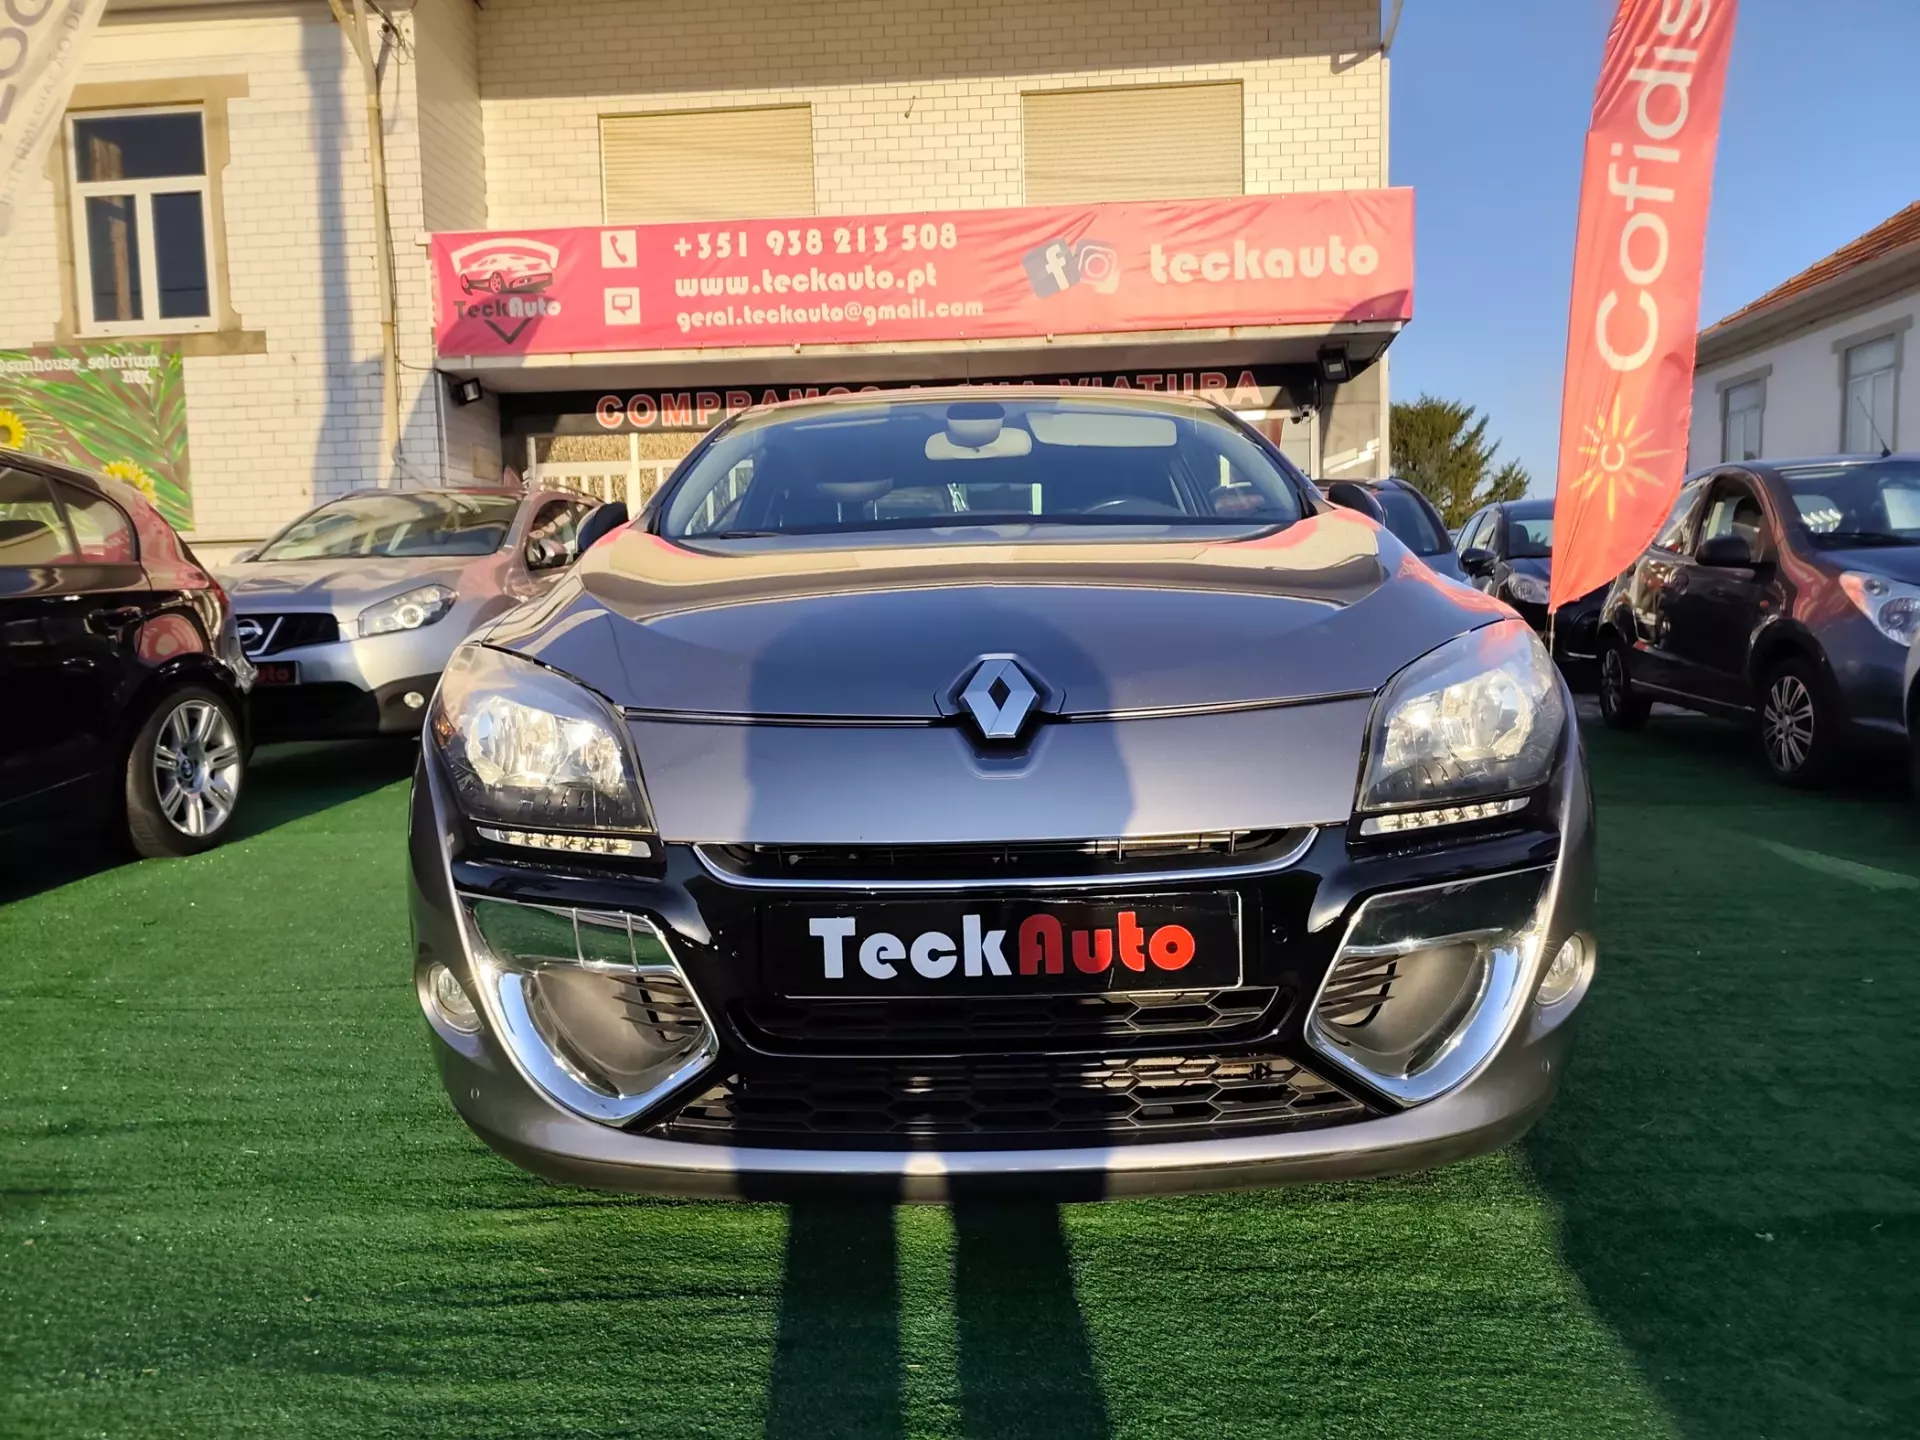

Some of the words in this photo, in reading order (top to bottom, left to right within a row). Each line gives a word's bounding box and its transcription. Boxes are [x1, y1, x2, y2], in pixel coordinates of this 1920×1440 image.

[2, 37, 73, 205] INTERMEDIAÃO
[1596, 0, 1708, 372] Cofidis
[674, 231, 747, 259] +351
[766, 229, 823, 256] 938
[833, 226, 888, 253] 213
[901, 222, 957, 250] 508
[1150, 235, 1380, 284] teckauto
[675, 262, 937, 297] www.teckauto.pt
[453, 297, 562, 319] TeckAuto
[676, 297, 984, 333] geral.teckauto@gmail.com
[809, 911, 1196, 980] TeckAuto
